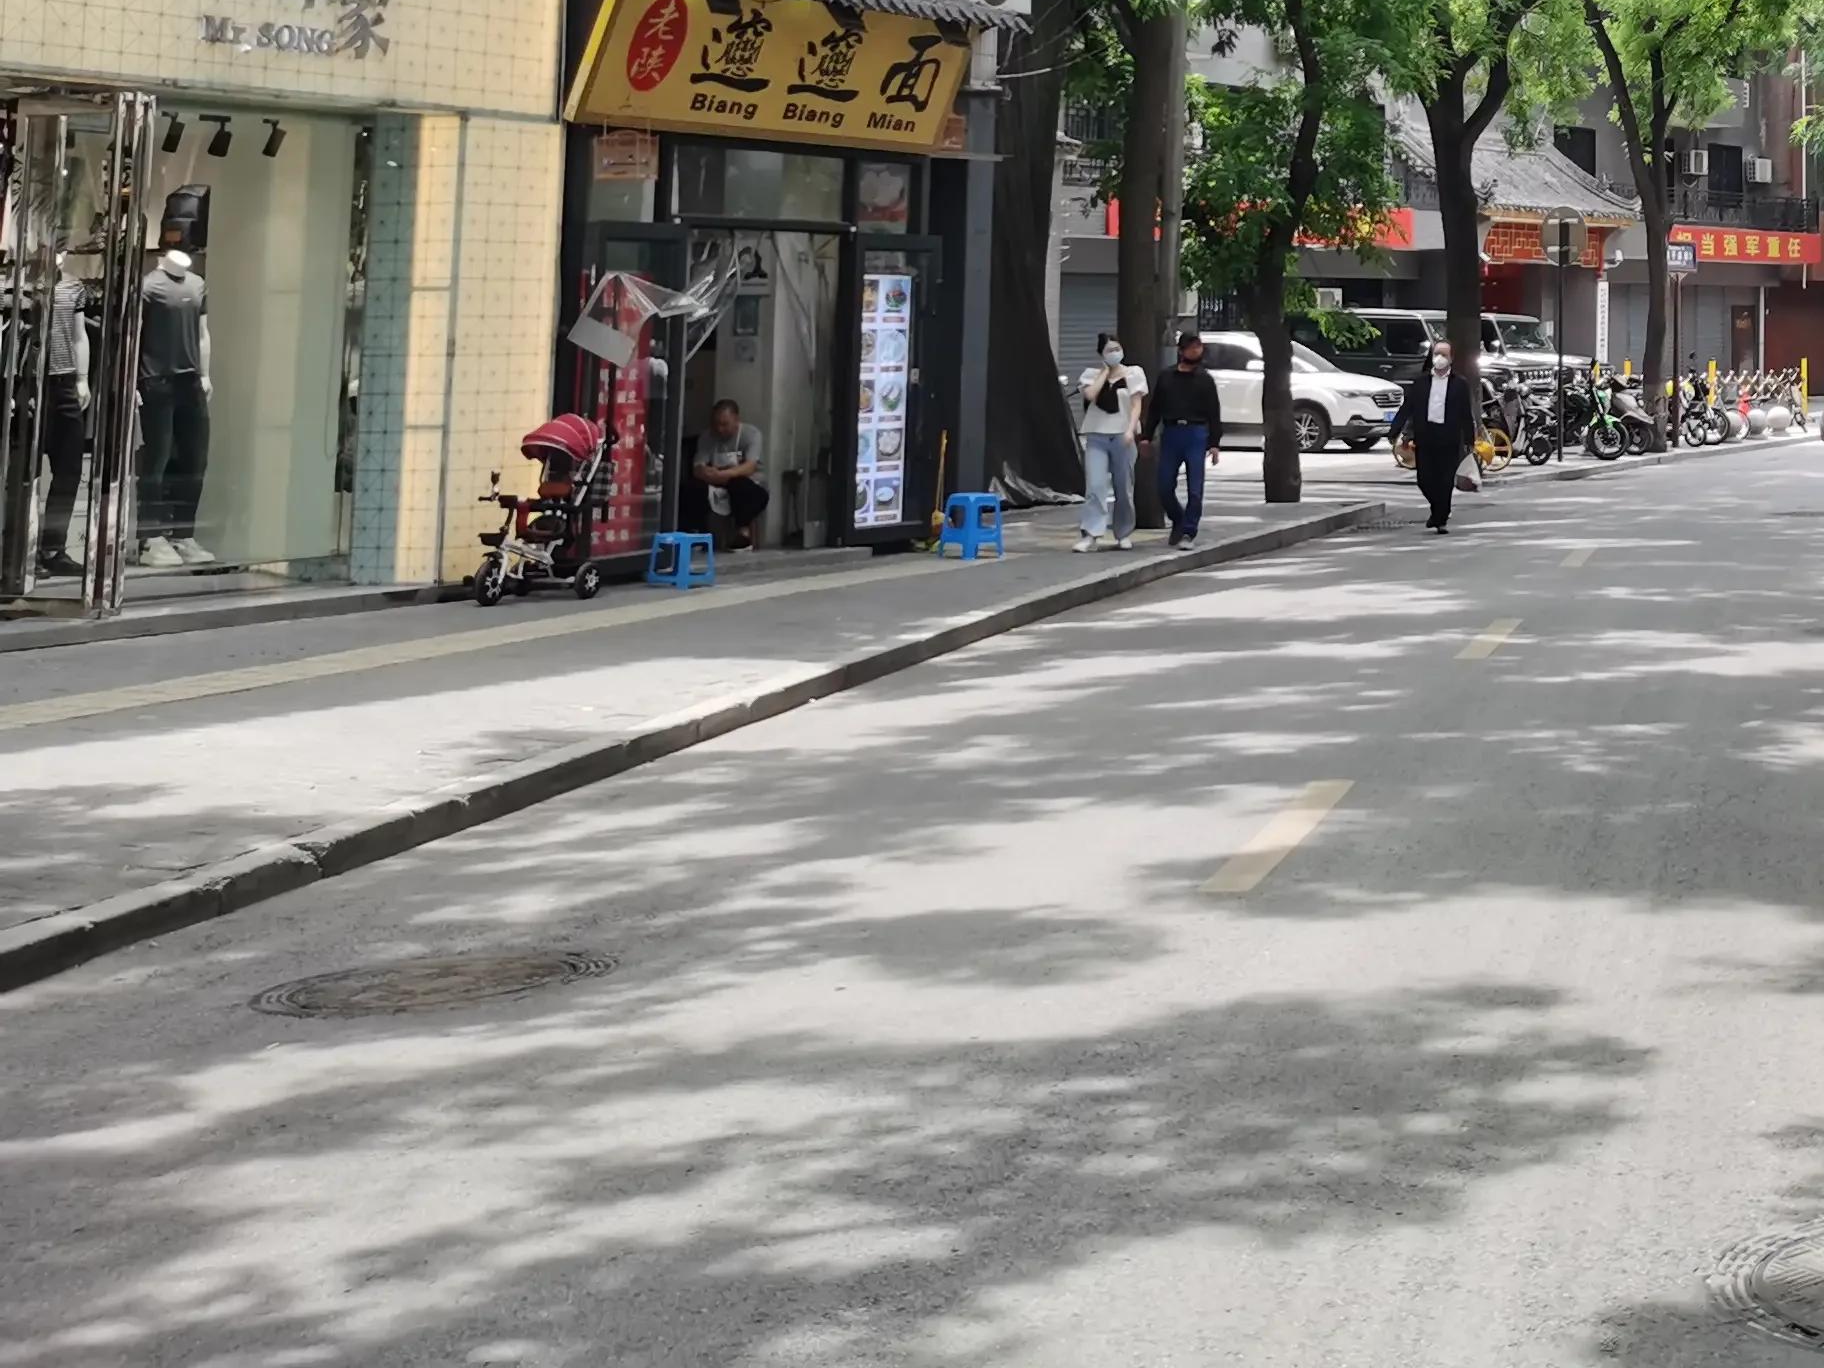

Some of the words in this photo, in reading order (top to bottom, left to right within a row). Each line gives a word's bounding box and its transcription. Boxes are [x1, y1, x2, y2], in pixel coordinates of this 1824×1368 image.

[690, 93, 758, 120] Biang
[782, 103, 845, 128] Biang
[866, 112, 916, 133] Mian
